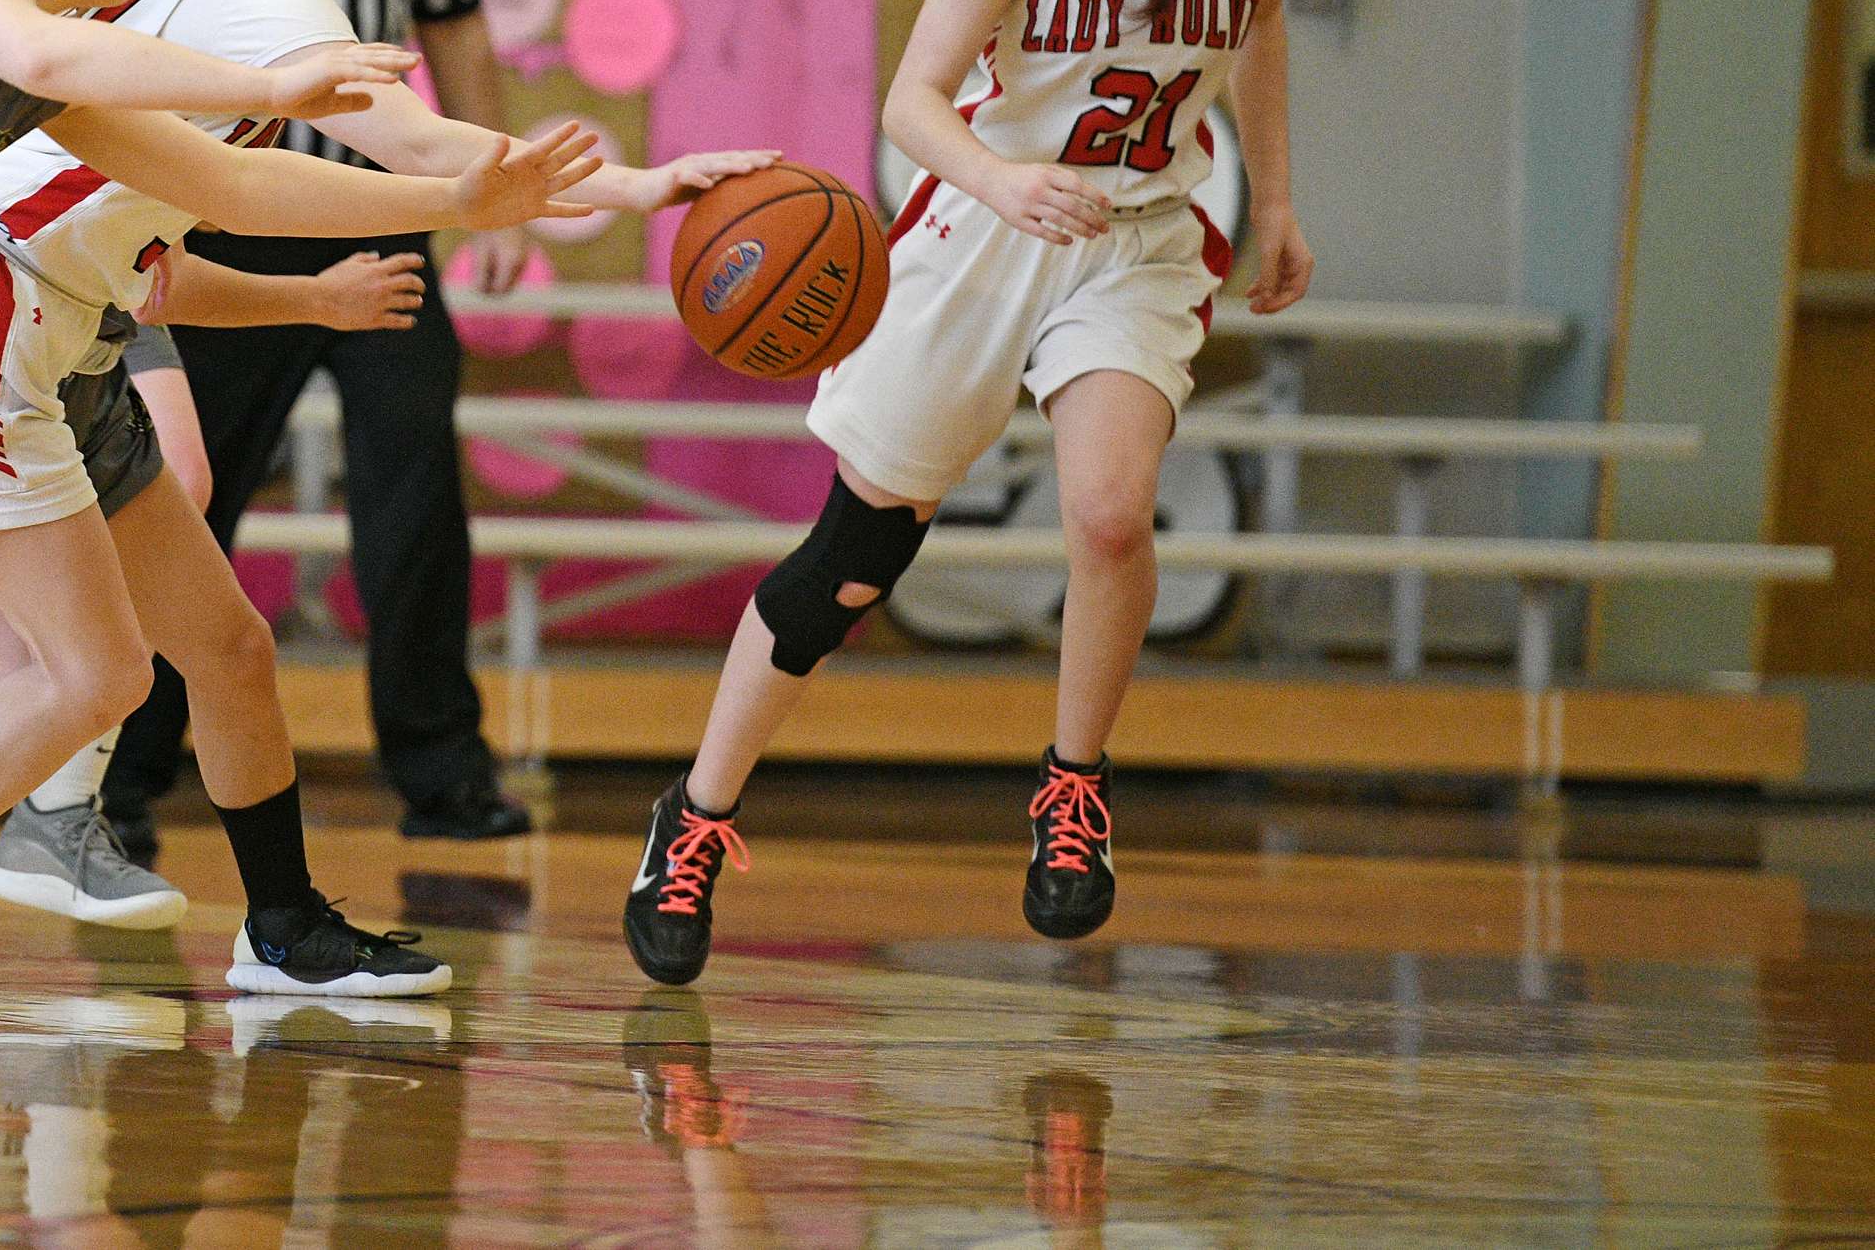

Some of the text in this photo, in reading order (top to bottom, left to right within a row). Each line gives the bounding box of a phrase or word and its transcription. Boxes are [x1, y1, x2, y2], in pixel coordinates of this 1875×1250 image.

[1057, 66, 1202, 173] 21
[740, 257, 851, 374] THE ROCK
